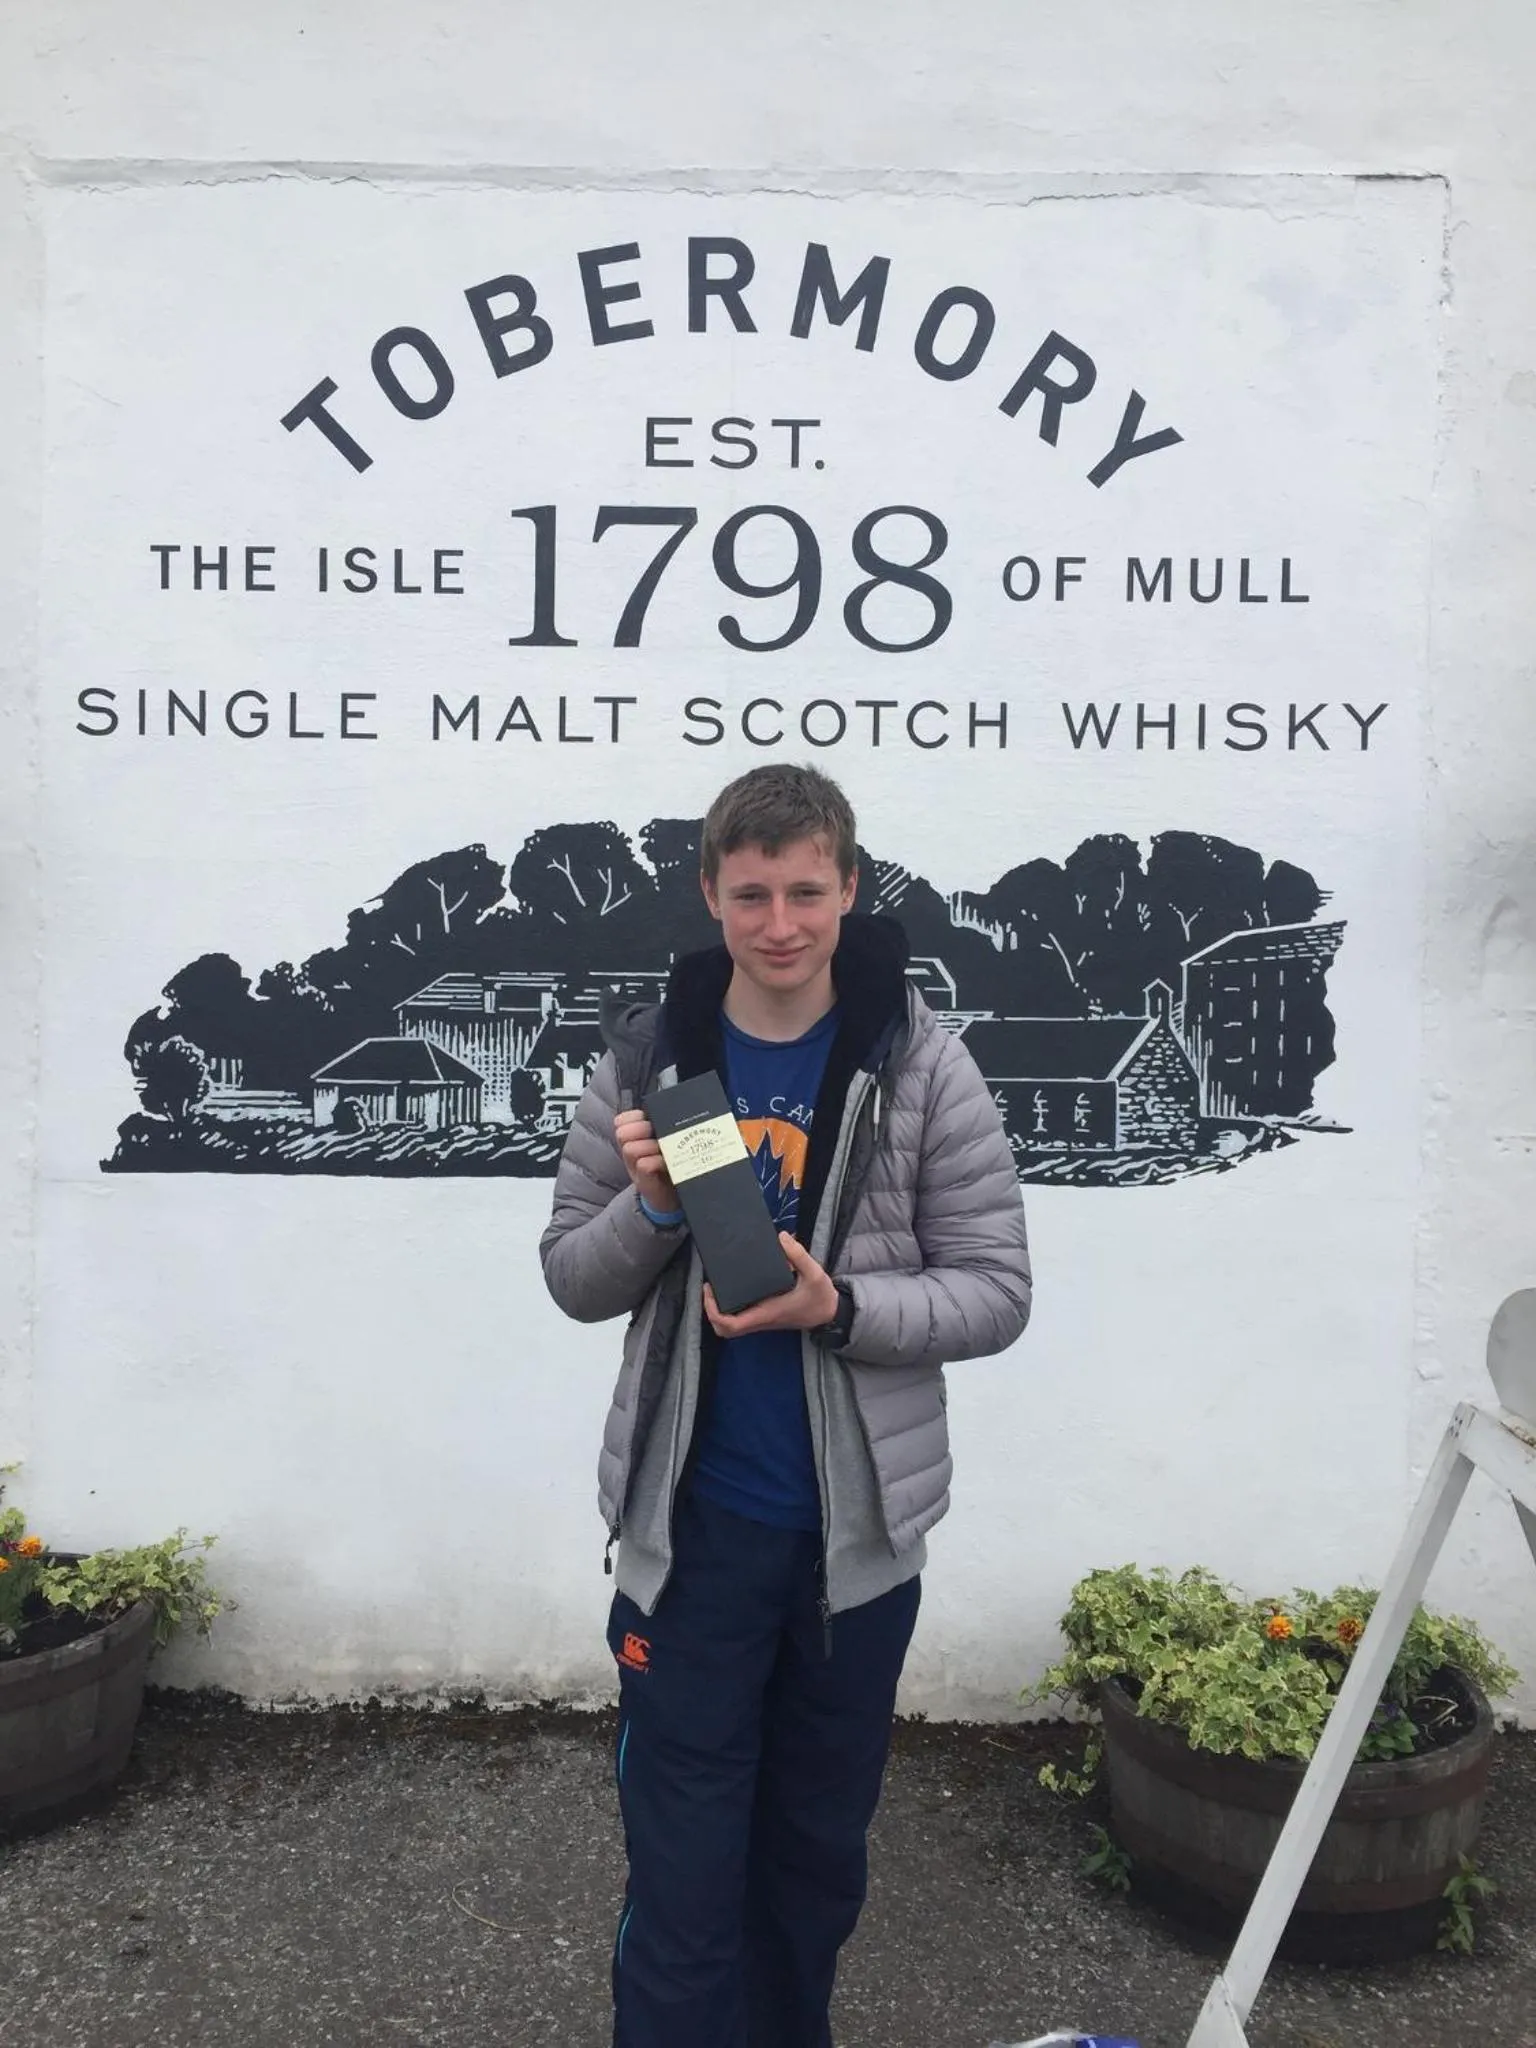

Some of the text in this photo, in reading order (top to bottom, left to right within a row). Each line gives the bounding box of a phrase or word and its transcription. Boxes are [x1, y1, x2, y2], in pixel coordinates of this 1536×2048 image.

[280, 236, 1183, 488] TOBERMORY
[645, 417, 826, 469] EST.
[150, 545, 464, 595] THE ISLE
[509, 504, 953, 654] 1798
[1002, 555, 1310, 604] OF MULL
[76, 687, 1388, 751] SINGLE MALT SCOTCH WHISKY
